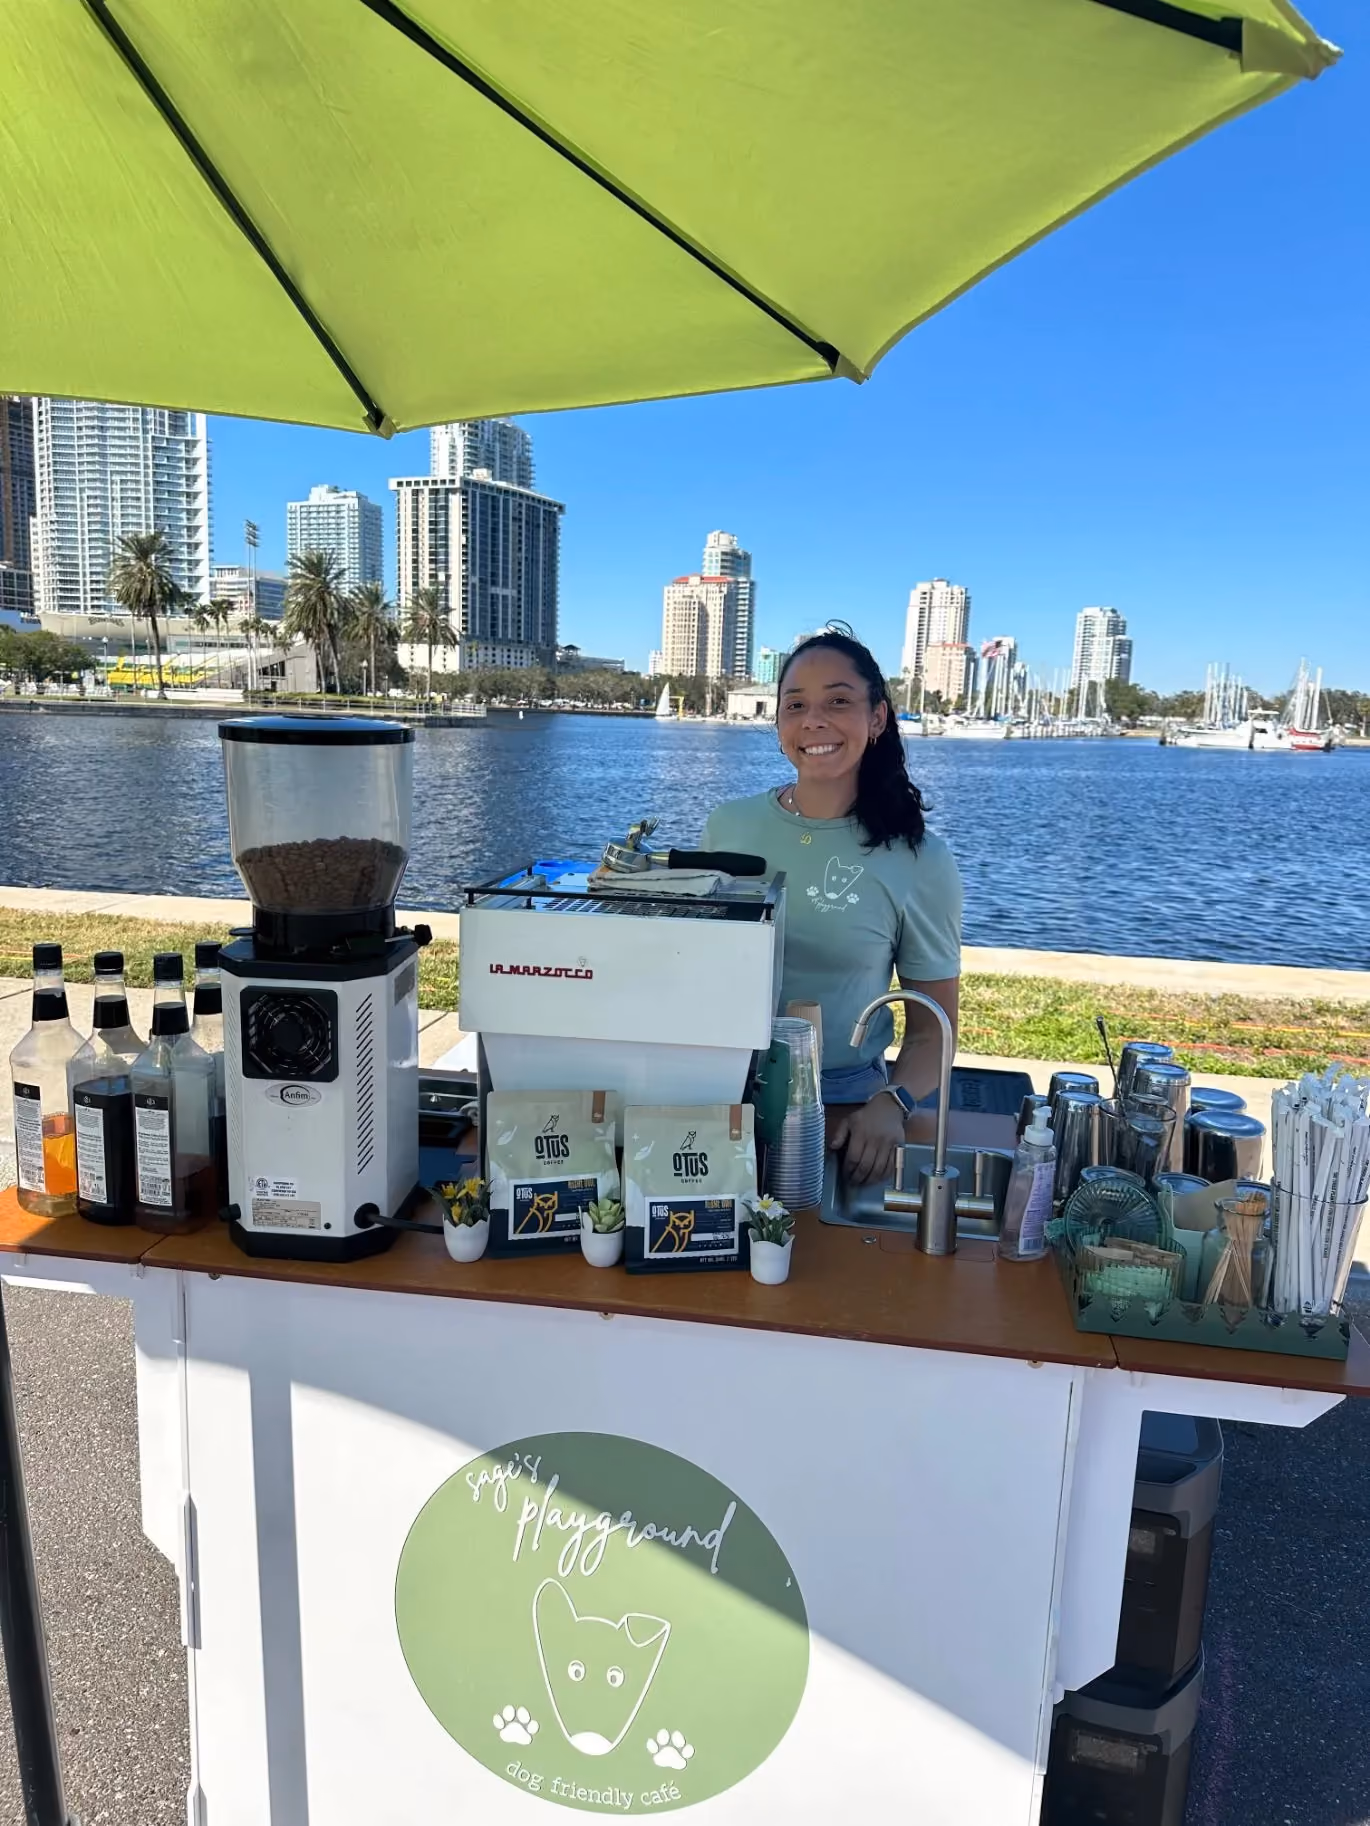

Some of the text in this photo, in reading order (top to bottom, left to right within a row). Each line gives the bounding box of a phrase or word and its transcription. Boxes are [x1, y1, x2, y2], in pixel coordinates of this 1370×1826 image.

[489, 963, 594, 980] LA MARZOCCO
[284, 1090, 310, 1101] Anfim
[534, 1133, 570, 1160] OTUS
[672, 1151, 709, 1178] OTUS
[515, 1187, 533, 1200] OTUS
[651, 1204, 670, 1218] OTUS
[466, 1453, 541, 1512] sage's
[512, 1473, 737, 1577] playground
[506, 1760, 683, 1810] dog friendly café
